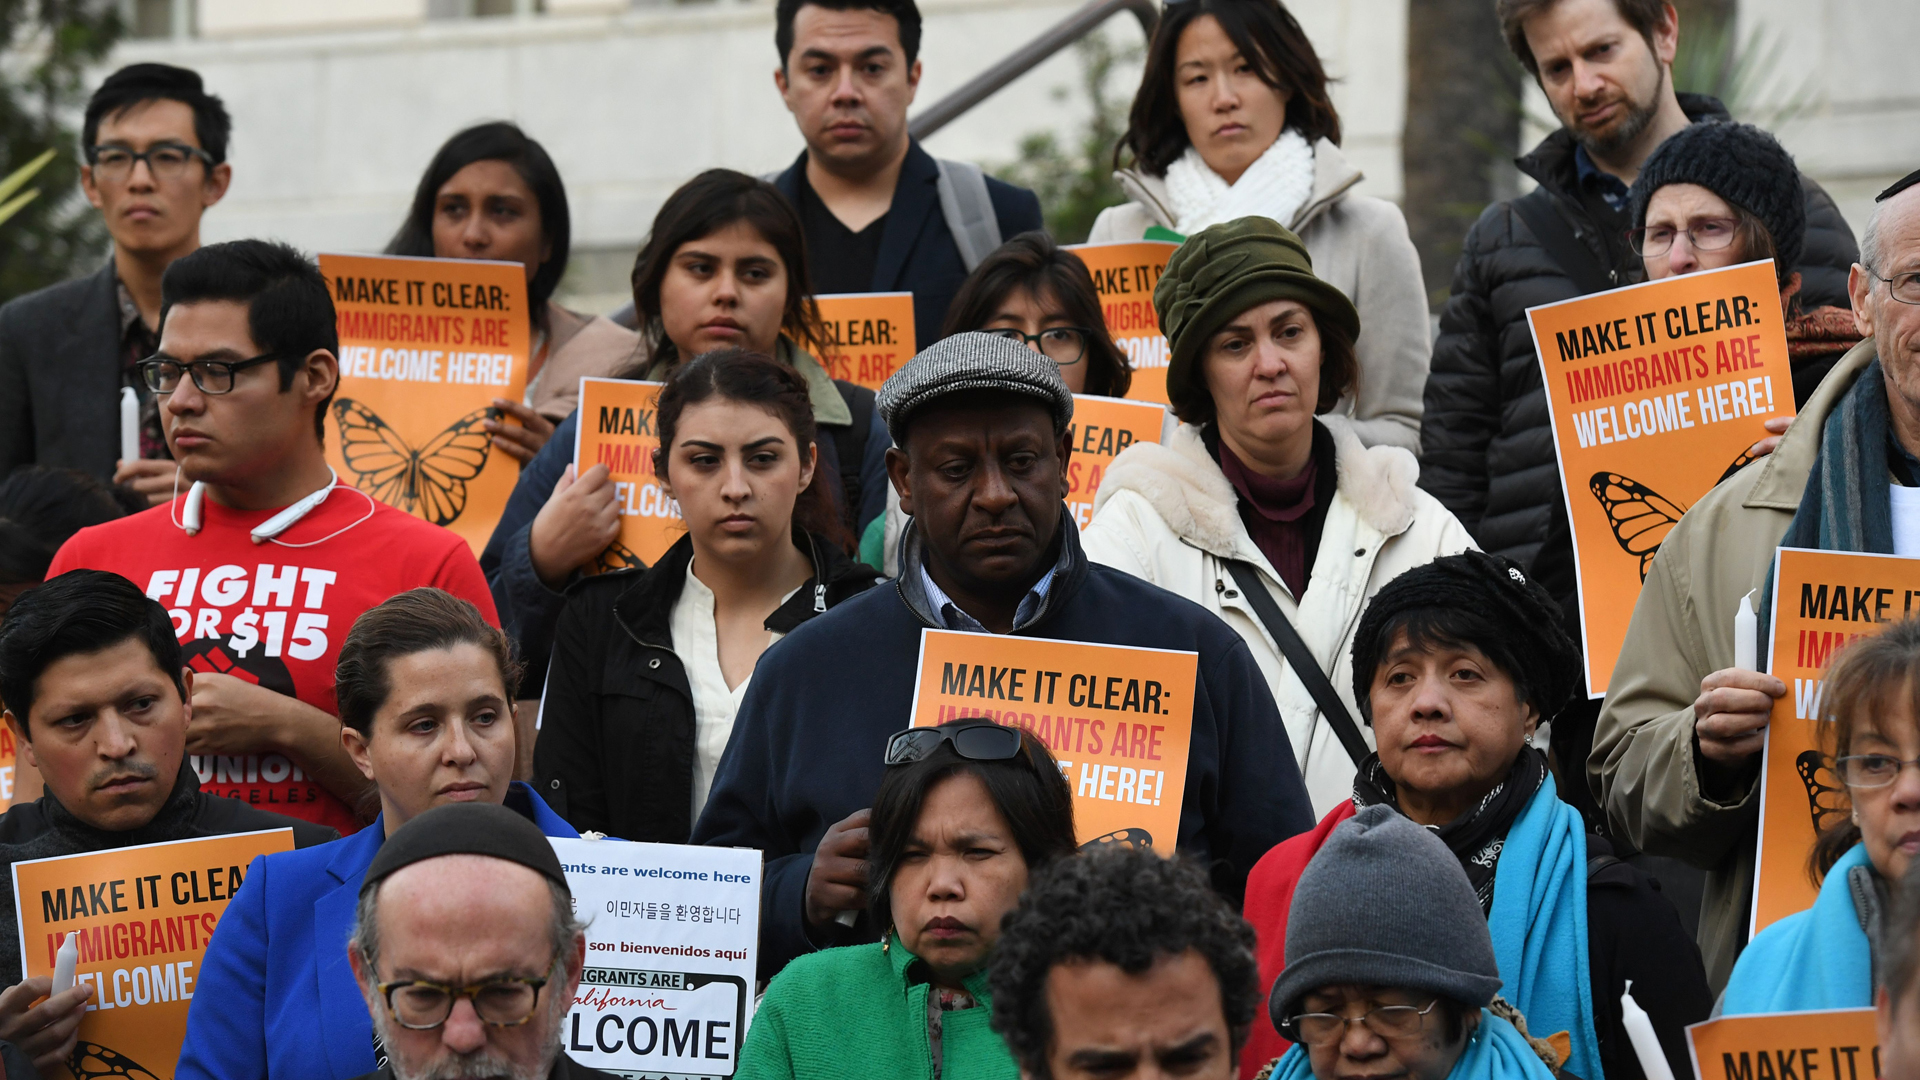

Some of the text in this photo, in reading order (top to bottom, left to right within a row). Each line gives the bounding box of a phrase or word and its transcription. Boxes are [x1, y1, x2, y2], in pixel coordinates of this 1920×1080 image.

[336, 277, 511, 311] MAKE IT CLEAR:
[1094, 267, 1131, 295] AKE
[1135, 265, 1150, 292] IT
[337, 311, 509, 347] IMMIGRANTS ARE
[1556, 295, 1761, 362] MAKE IT CLEAR:
[338, 346, 513, 386] WELCOME HERE!
[1565, 334, 1764, 404] IMMIGRANTS ARE
[1572, 376, 1775, 449] WELCOME HERE!
[146, 563, 337, 609] FIGHT
[1800, 583, 1894, 623] MAKE
[168, 607, 329, 661] OR $15
[940, 662, 1171, 715] MAKE IT CLEAR:
[1110, 722, 1165, 761] ARE
[1078, 762, 1164, 806] HERE!
[560, 863, 751, 883] ants are welcome here
[41, 864, 250, 923] MAKE IT CLEA
[606, 899, 742, 925] 이민자들을 환영합니다
[589, 941, 747, 961] son bienvenidos aquí
[72, 961, 194, 1012] ELCOME
[580, 969, 680, 987] IGRANTS ARE
[572, 988, 678, 1012] alifornia
[564, 1012, 731, 1060] LCOME
